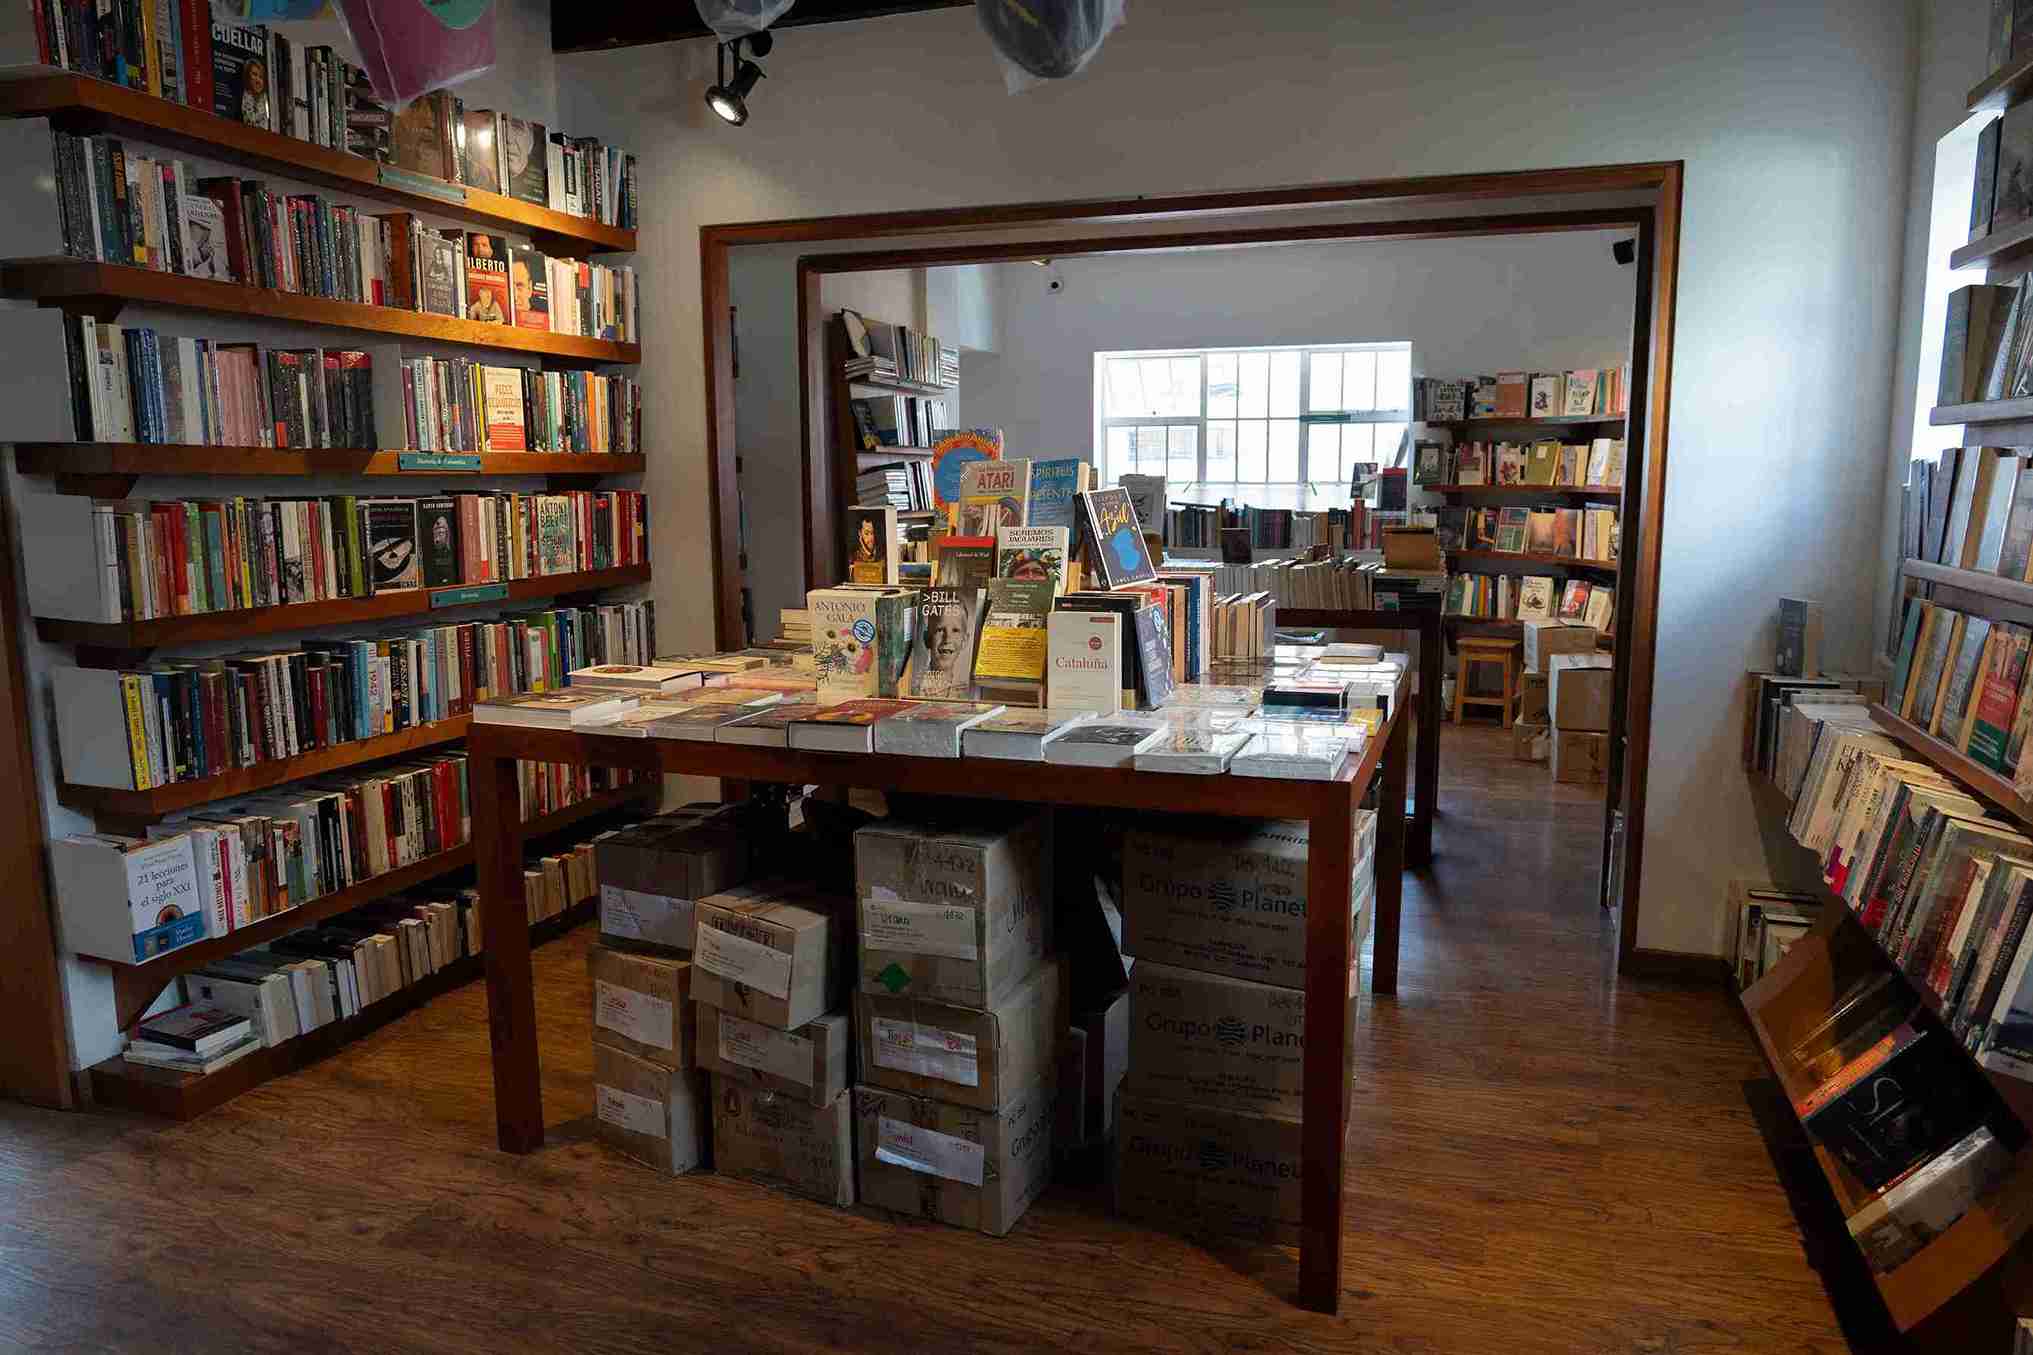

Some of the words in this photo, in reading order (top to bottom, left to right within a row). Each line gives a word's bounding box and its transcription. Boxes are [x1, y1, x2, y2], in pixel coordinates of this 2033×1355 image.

[212, 22, 265, 57] CUELLAR
[977, 471, 1014, 489] ATARI
[815, 600, 865, 612] ANTONIO
[922, 604, 960, 617] GATES
[137, 874, 149, 887] 21
[151, 863, 188, 881] lecciones
[151, 889, 172, 905] siglo
[172, 882, 191, 895] XXI
[156, 879, 175, 892] para
[1145, 1011, 1210, 1041] Grupo
